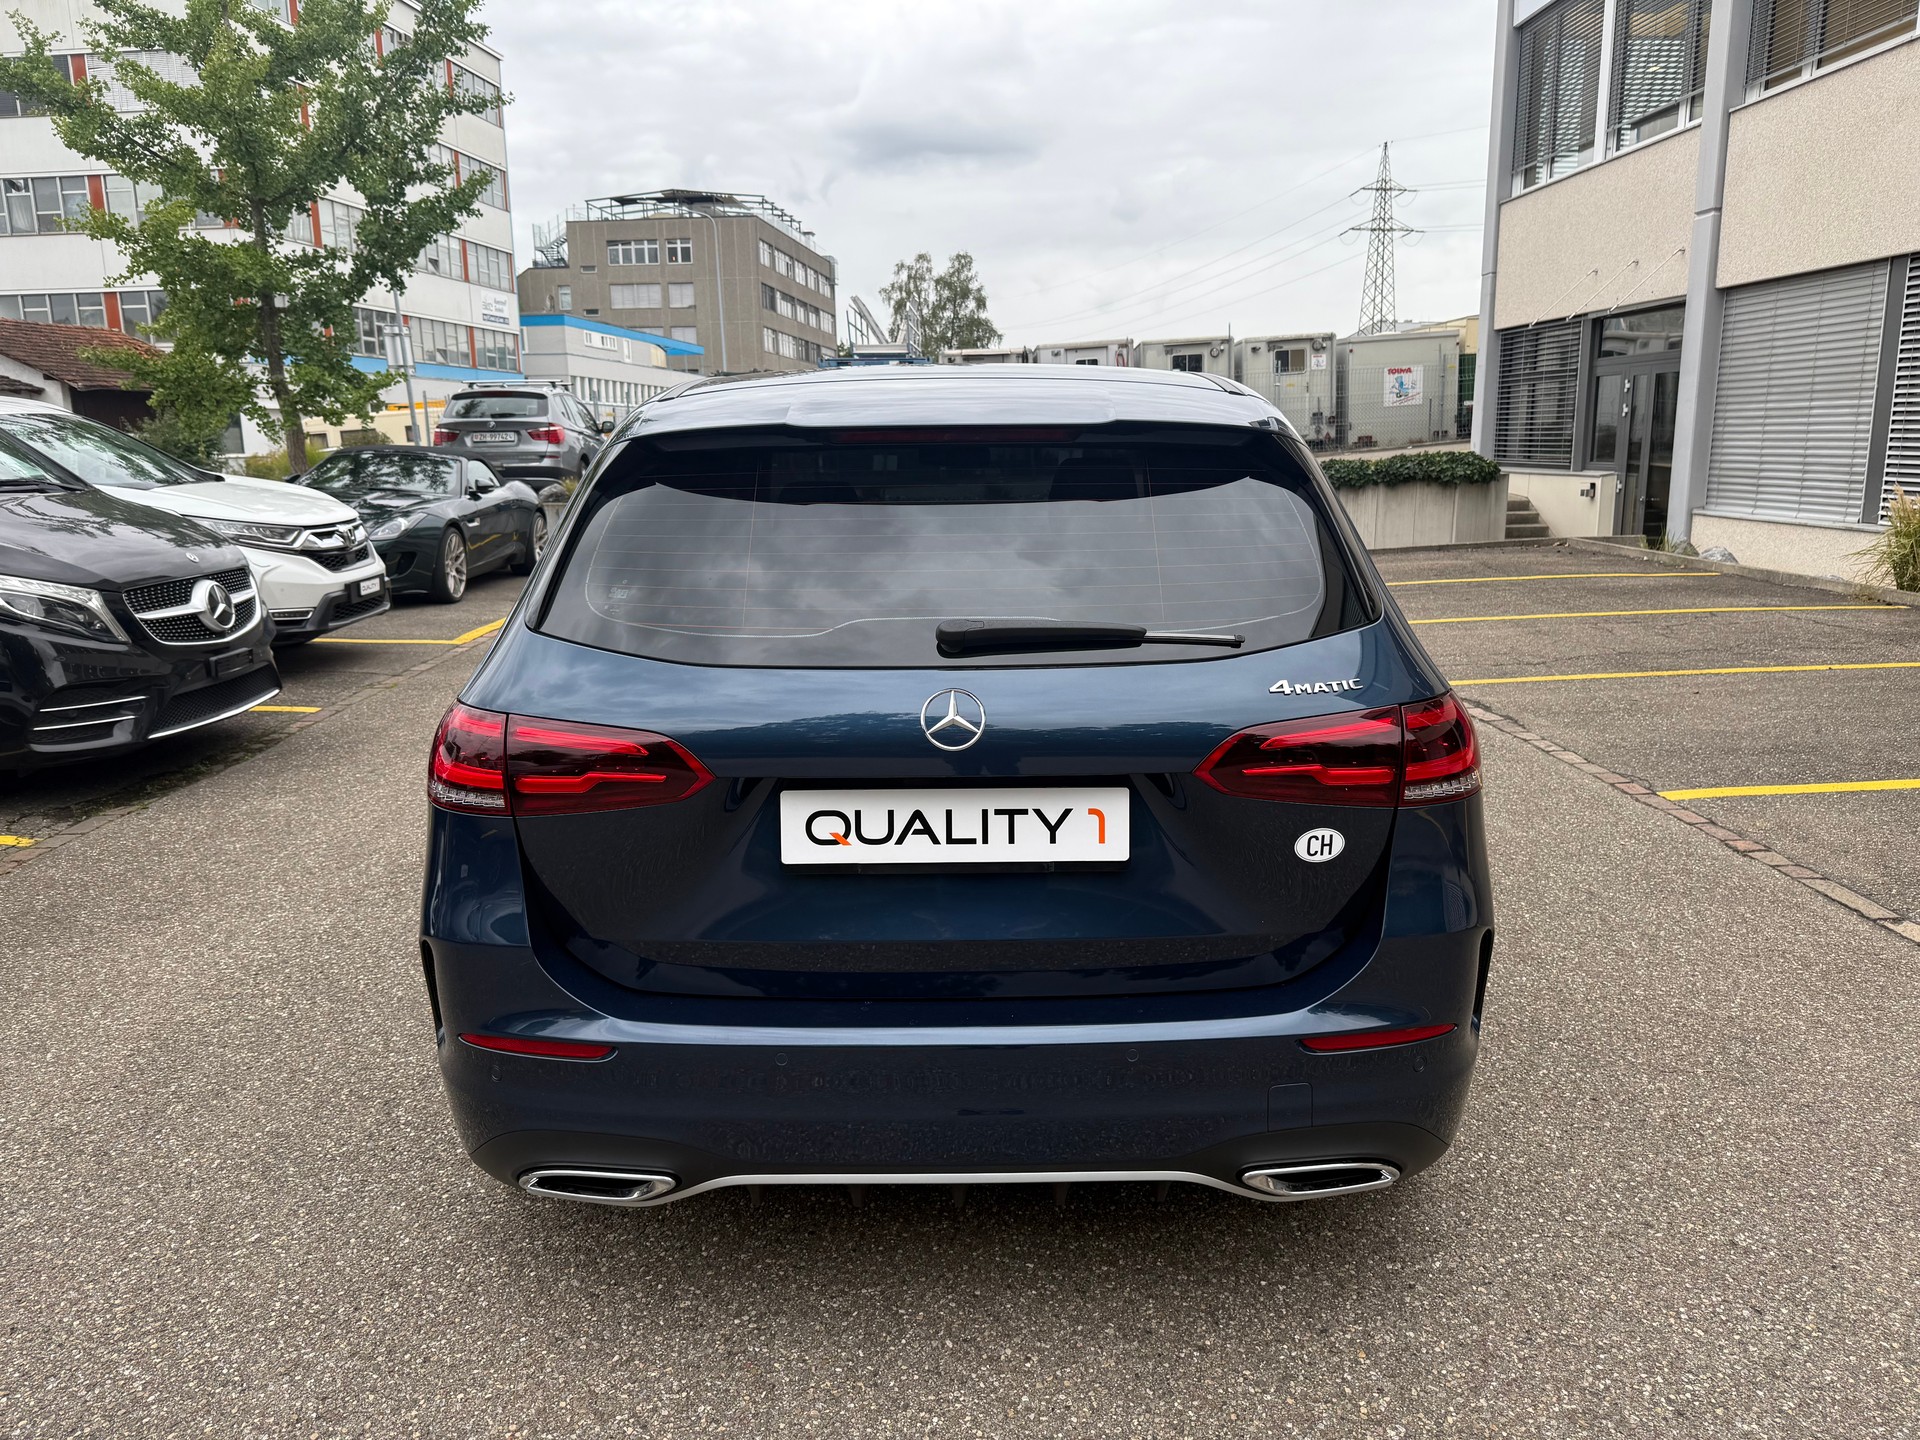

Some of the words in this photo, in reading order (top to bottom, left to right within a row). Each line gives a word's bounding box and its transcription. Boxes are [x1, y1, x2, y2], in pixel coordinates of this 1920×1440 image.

[1269, 678, 1363, 696] 4MATIC
[805, 808, 1074, 846] QUALITY
[1088, 809, 1106, 844] 1
[1307, 835, 1333, 857] CH
